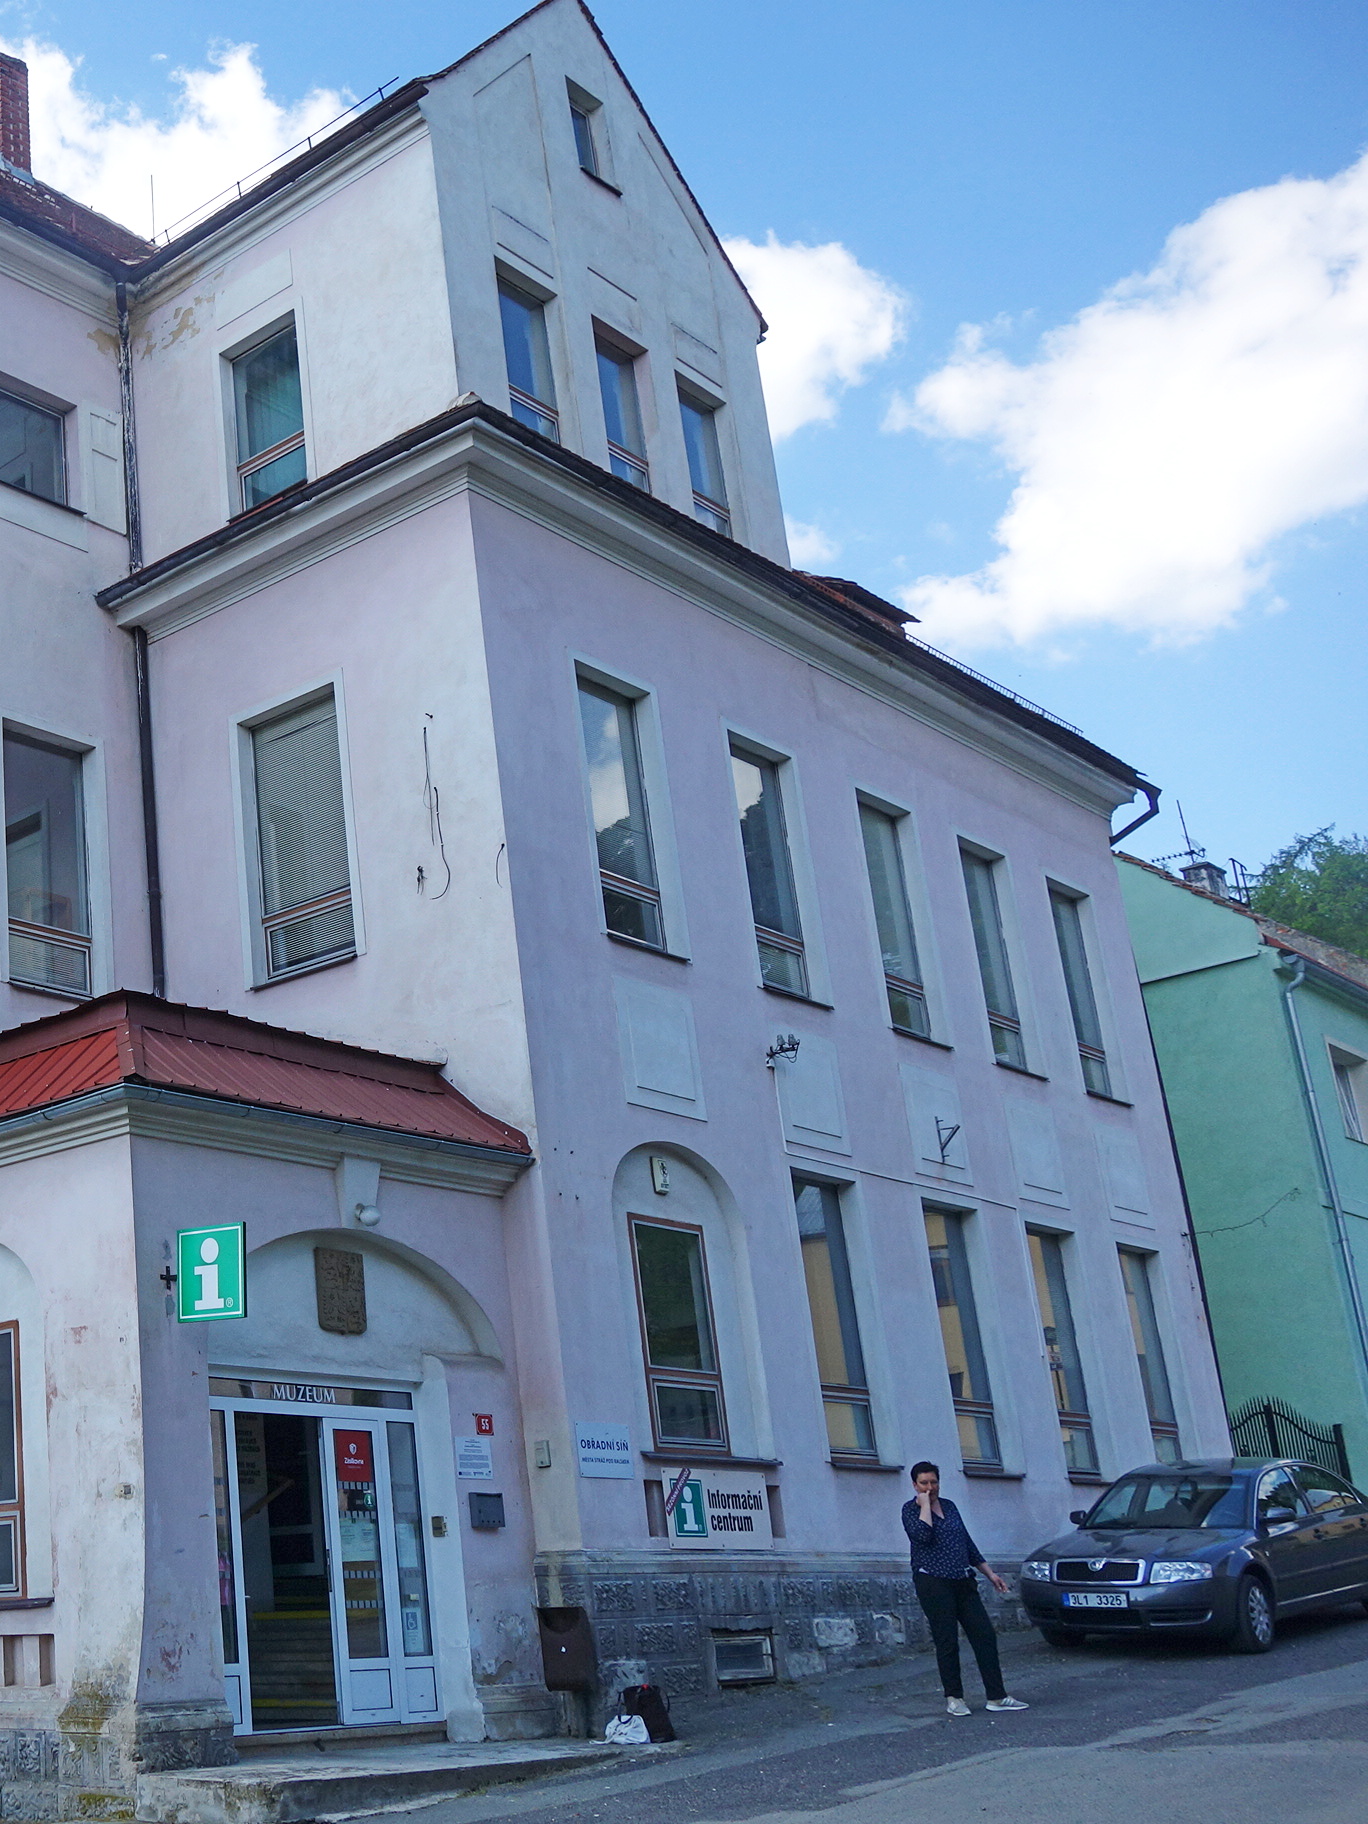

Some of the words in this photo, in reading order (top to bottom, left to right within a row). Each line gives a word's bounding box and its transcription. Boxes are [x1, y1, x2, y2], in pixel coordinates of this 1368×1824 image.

[273, 1384, 336, 1403] MUZEUM
[481, 1418, 490, 1430] 55
[580, 1437, 615, 1450] OBŘADNÍ
[616, 1439, 629, 1451] SÍŇ
[707, 1489, 763, 1510] Informační
[711, 1512, 754, 1532] centrum
[1071, 1594, 1089, 1606] 3L1
[1096, 1595, 1122, 1606] 3325
